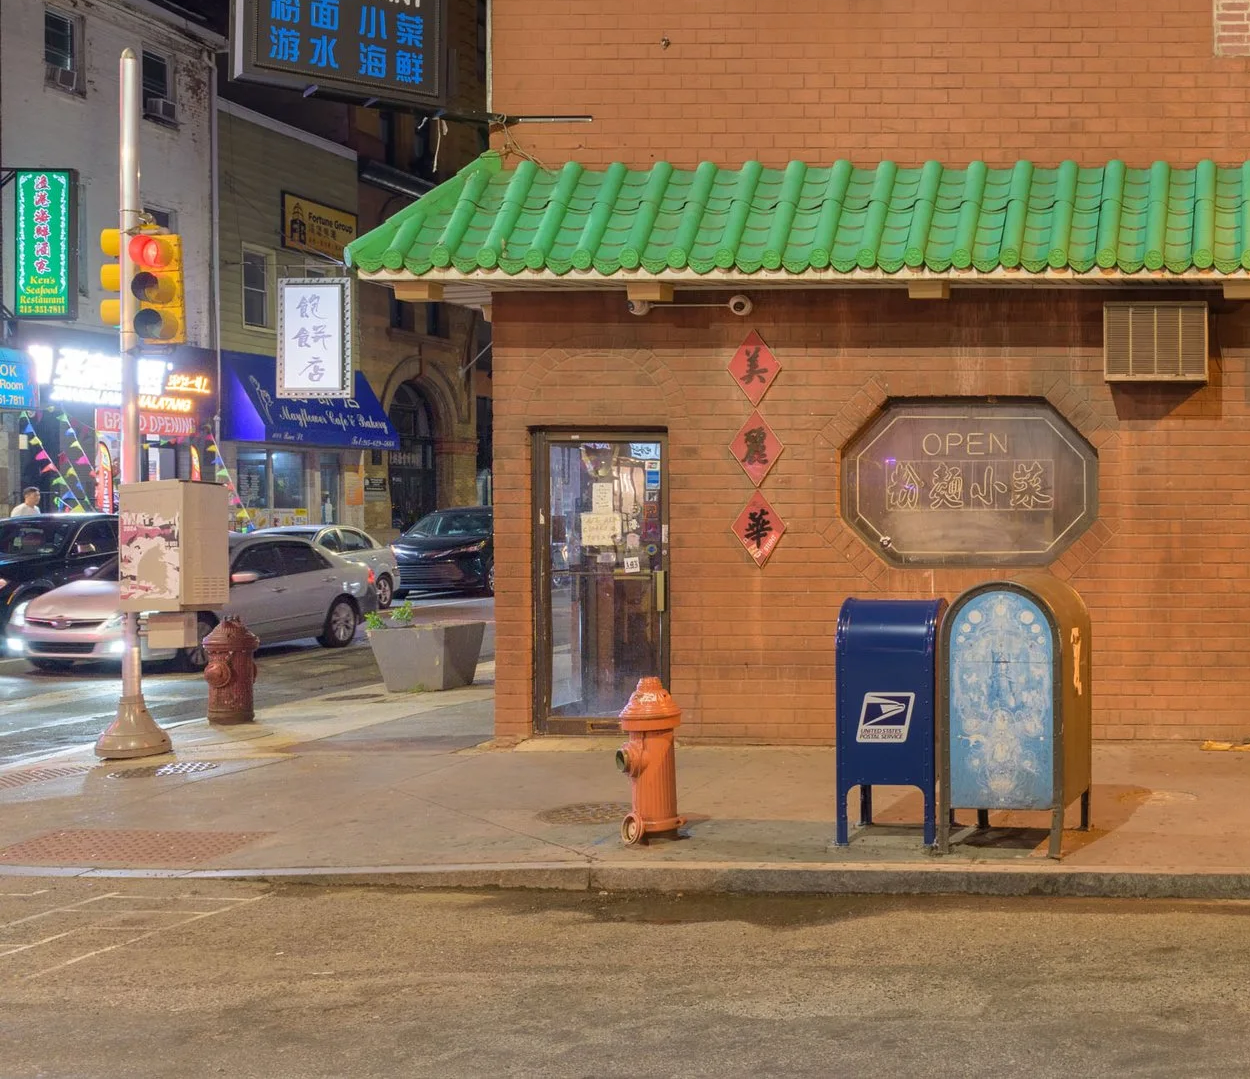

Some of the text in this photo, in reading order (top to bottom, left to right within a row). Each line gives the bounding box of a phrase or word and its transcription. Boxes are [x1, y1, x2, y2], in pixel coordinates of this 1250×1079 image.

[20, 295, 65, 304] Restaurant
[103, 411, 196, 434] GRD OPENING
[922, 432, 1008, 456] OPEN
